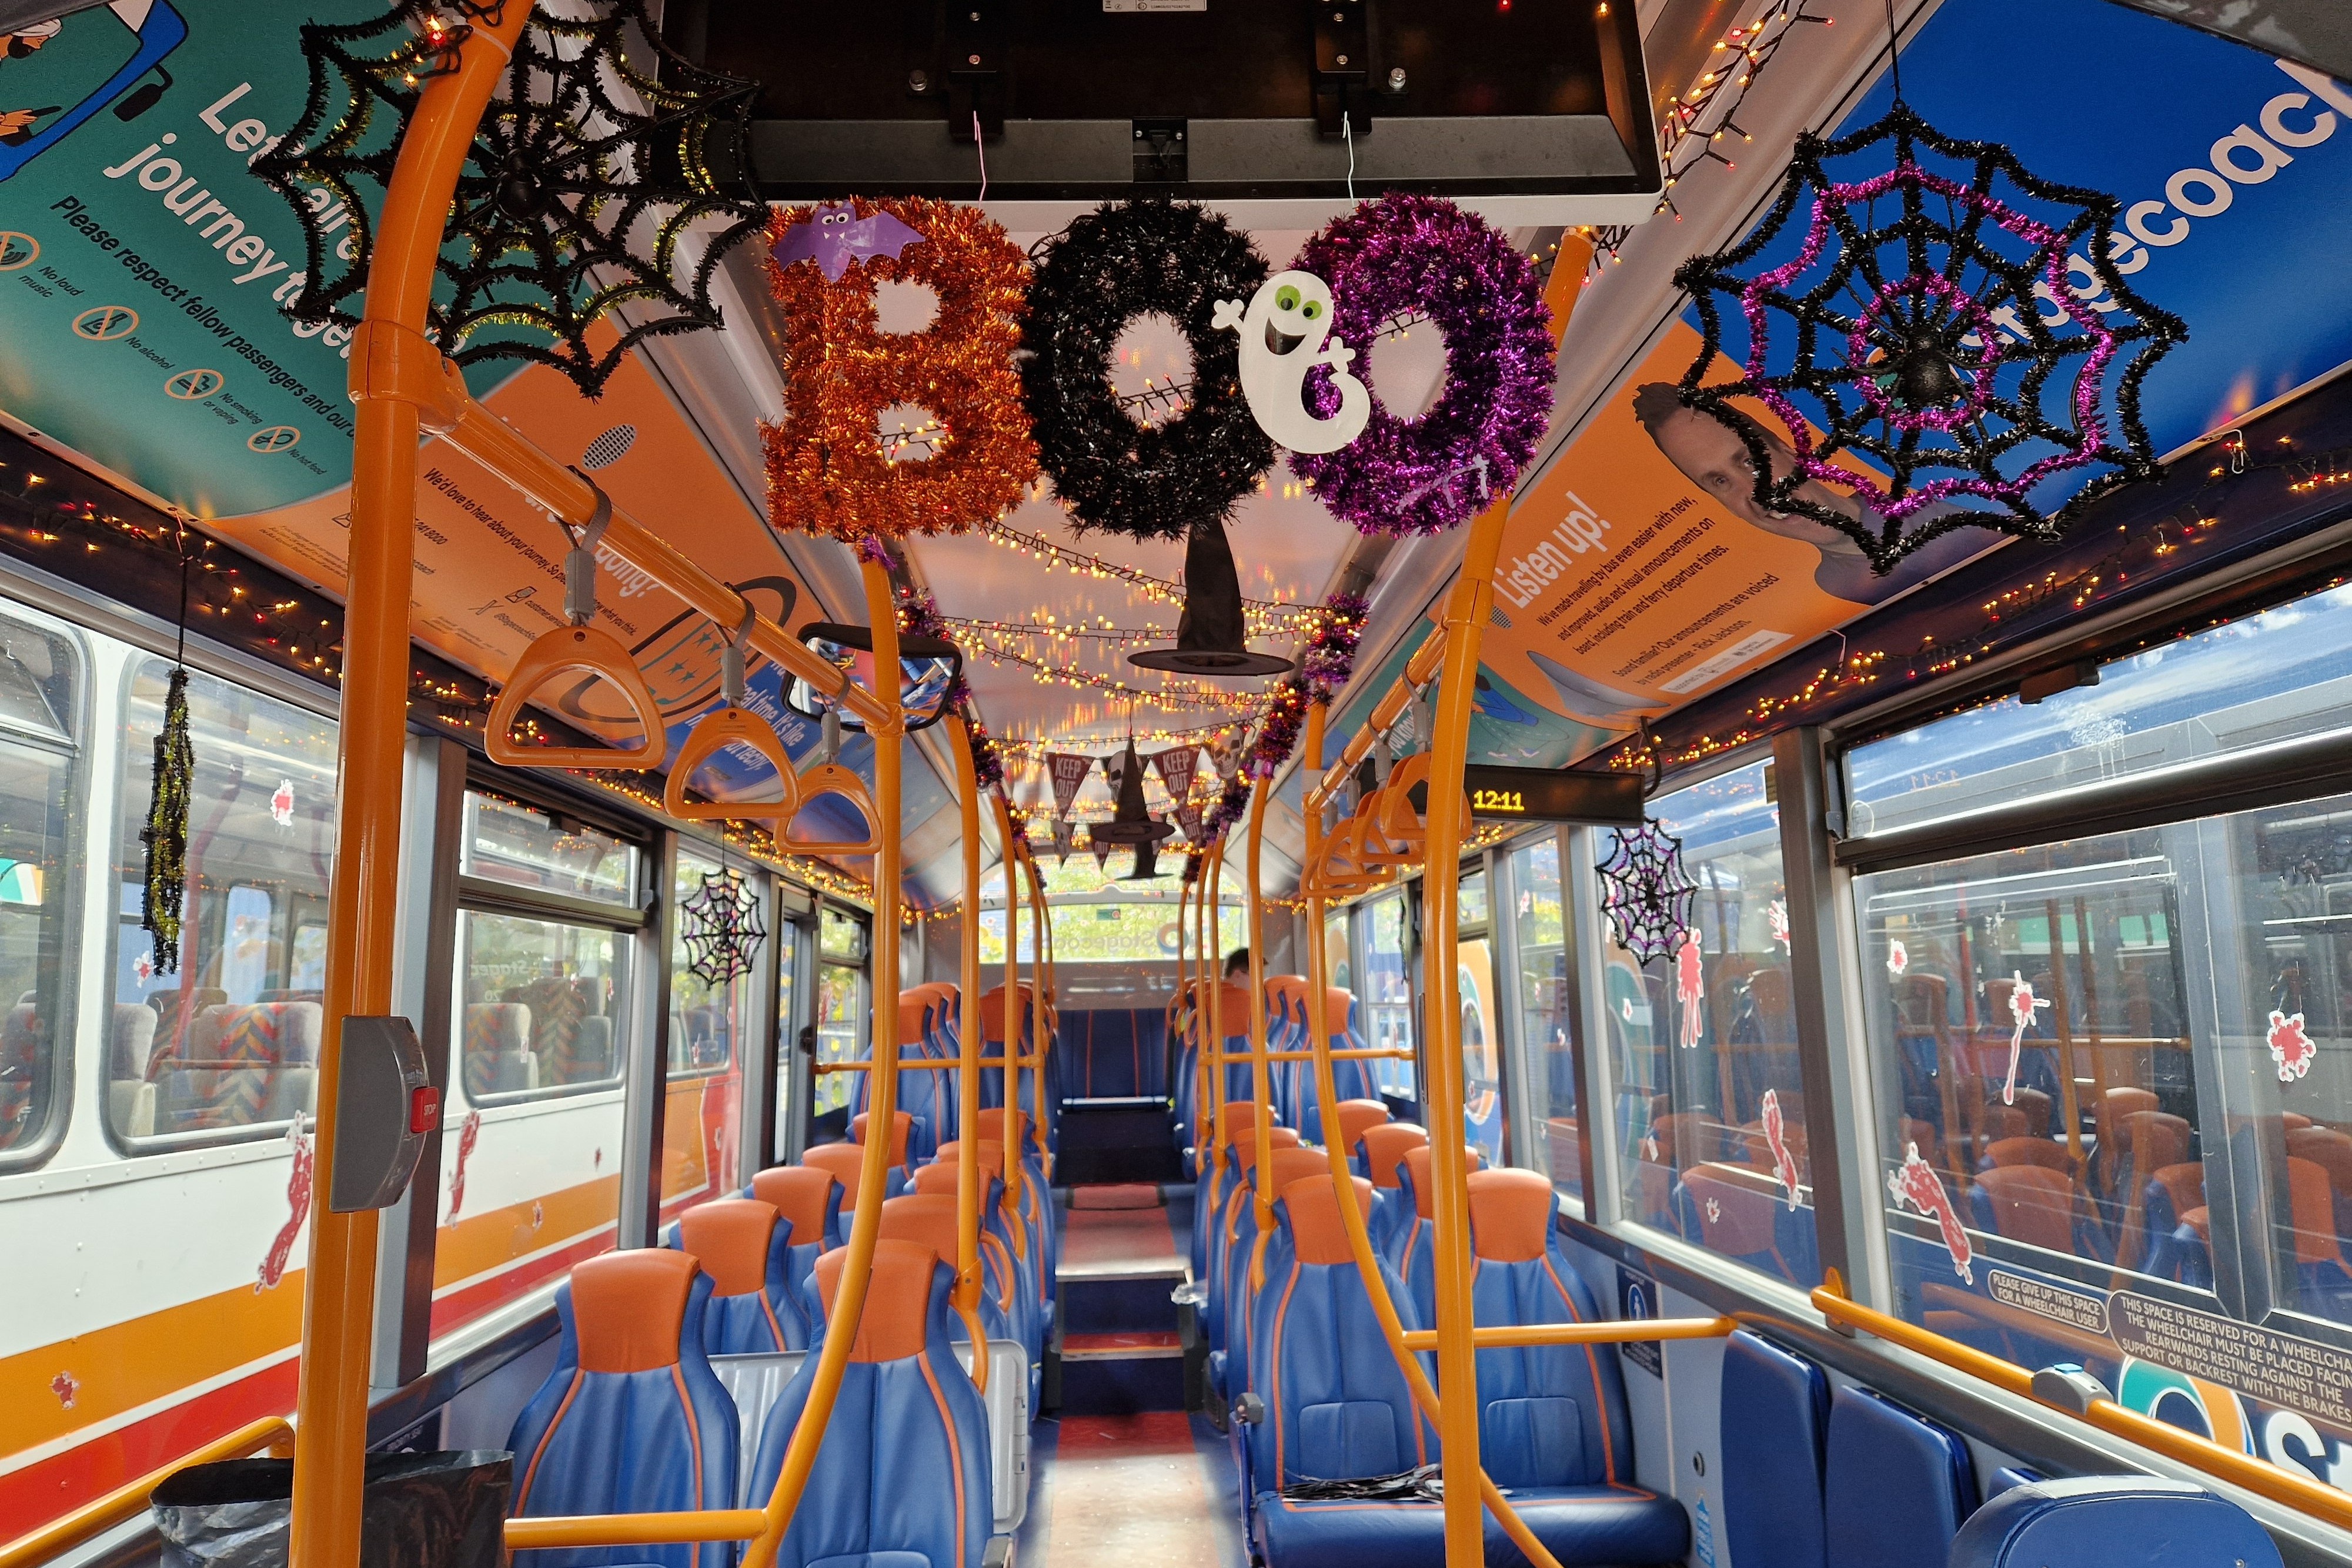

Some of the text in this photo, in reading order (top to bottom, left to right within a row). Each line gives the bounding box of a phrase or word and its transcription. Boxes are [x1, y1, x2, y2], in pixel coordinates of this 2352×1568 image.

[103, 132, 289, 285] journey
[19, 275, 53, 297] music
[38, 266, 85, 296] No loud
[49, 195, 119, 251] Please
[113, 248, 189, 302] respect
[179, 296, 235, 338] fellow
[222, 335, 308, 397] passengers
[302, 393, 337, 415] and
[326, 413, 353, 433] our
[125, 337, 175, 370] No alcohol
[756, 192, 1557, 541] BOO
[212, 406, 239, 425] vaping
[219, 393, 263, 424] No smoking
[288, 449, 327, 475] No hot food
[423, 468, 453, 491] We'd
[444, 485, 466, 504] love
[462, 499, 473, 511] to
[470, 504, 492, 523] hear
[487, 519, 514, 540] about
[506, 533, 528, 555] your
[523, 544, 549, 571] journey.
[546, 564, 559, 577] So
[601, 607, 619, 620] what
[424, 529, 448, 546] 8000
[1492, 490, 1611, 609] Listen up!
[1536, 495, 1699, 626] We've made travelling by bus even easier with new,
[1558, 516, 1716, 641] and improved, audio and visual announcements on
[1572, 543, 1730, 655] board, including train and ferry departure times.
[1612, 572, 1780, 678] Sound familiar? Our announcements are voiced
[1661, 650, 1697, 674] presenter
[780, 721, 806, 747] like
[1055, 757, 1081, 779] KEEP
[1162, 750, 1190, 774] KEEP
[1055, 780, 1076, 800] OUT
[1168, 772, 1188, 794] OUT
[1474, 790, 1525, 811] 12:11
[1185, 823, 1200, 838] OUT
[1095, 841, 1108, 855] OUT
[423, 1103, 437, 1116] STOP
[1993, 1273, 2101, 1316] PLEASE GIVE UP THIS SPACE
[1997, 1287, 2100, 1329] FOR A WHEELCHAIR USER
[2120, 1296, 2142, 1314] THIS
[2143, 1302, 2174, 1323] SPACE
[2176, 1310, 2185, 1326] IS
[2186, 1315, 2240, 1341] RESERVED
[2243, 1329, 2267, 1349] FOR
[2270, 1337, 2280, 1353] A
[2126, 1311, 2146, 1328] THE
[2147, 1317, 2213, 1349] WHEELCHAIR
[2215, 1336, 2246, 1358] MUST
[2249, 1346, 2264, 1364] BE
[2266, 1351, 2314, 1378] PLACED
[2122, 1337, 2352, 1424] SUPPORT OR BACKREST WITH THE BRAKES
[2145, 1330, 2344, 1405] REARWARDS RESTING AGAINST THE
